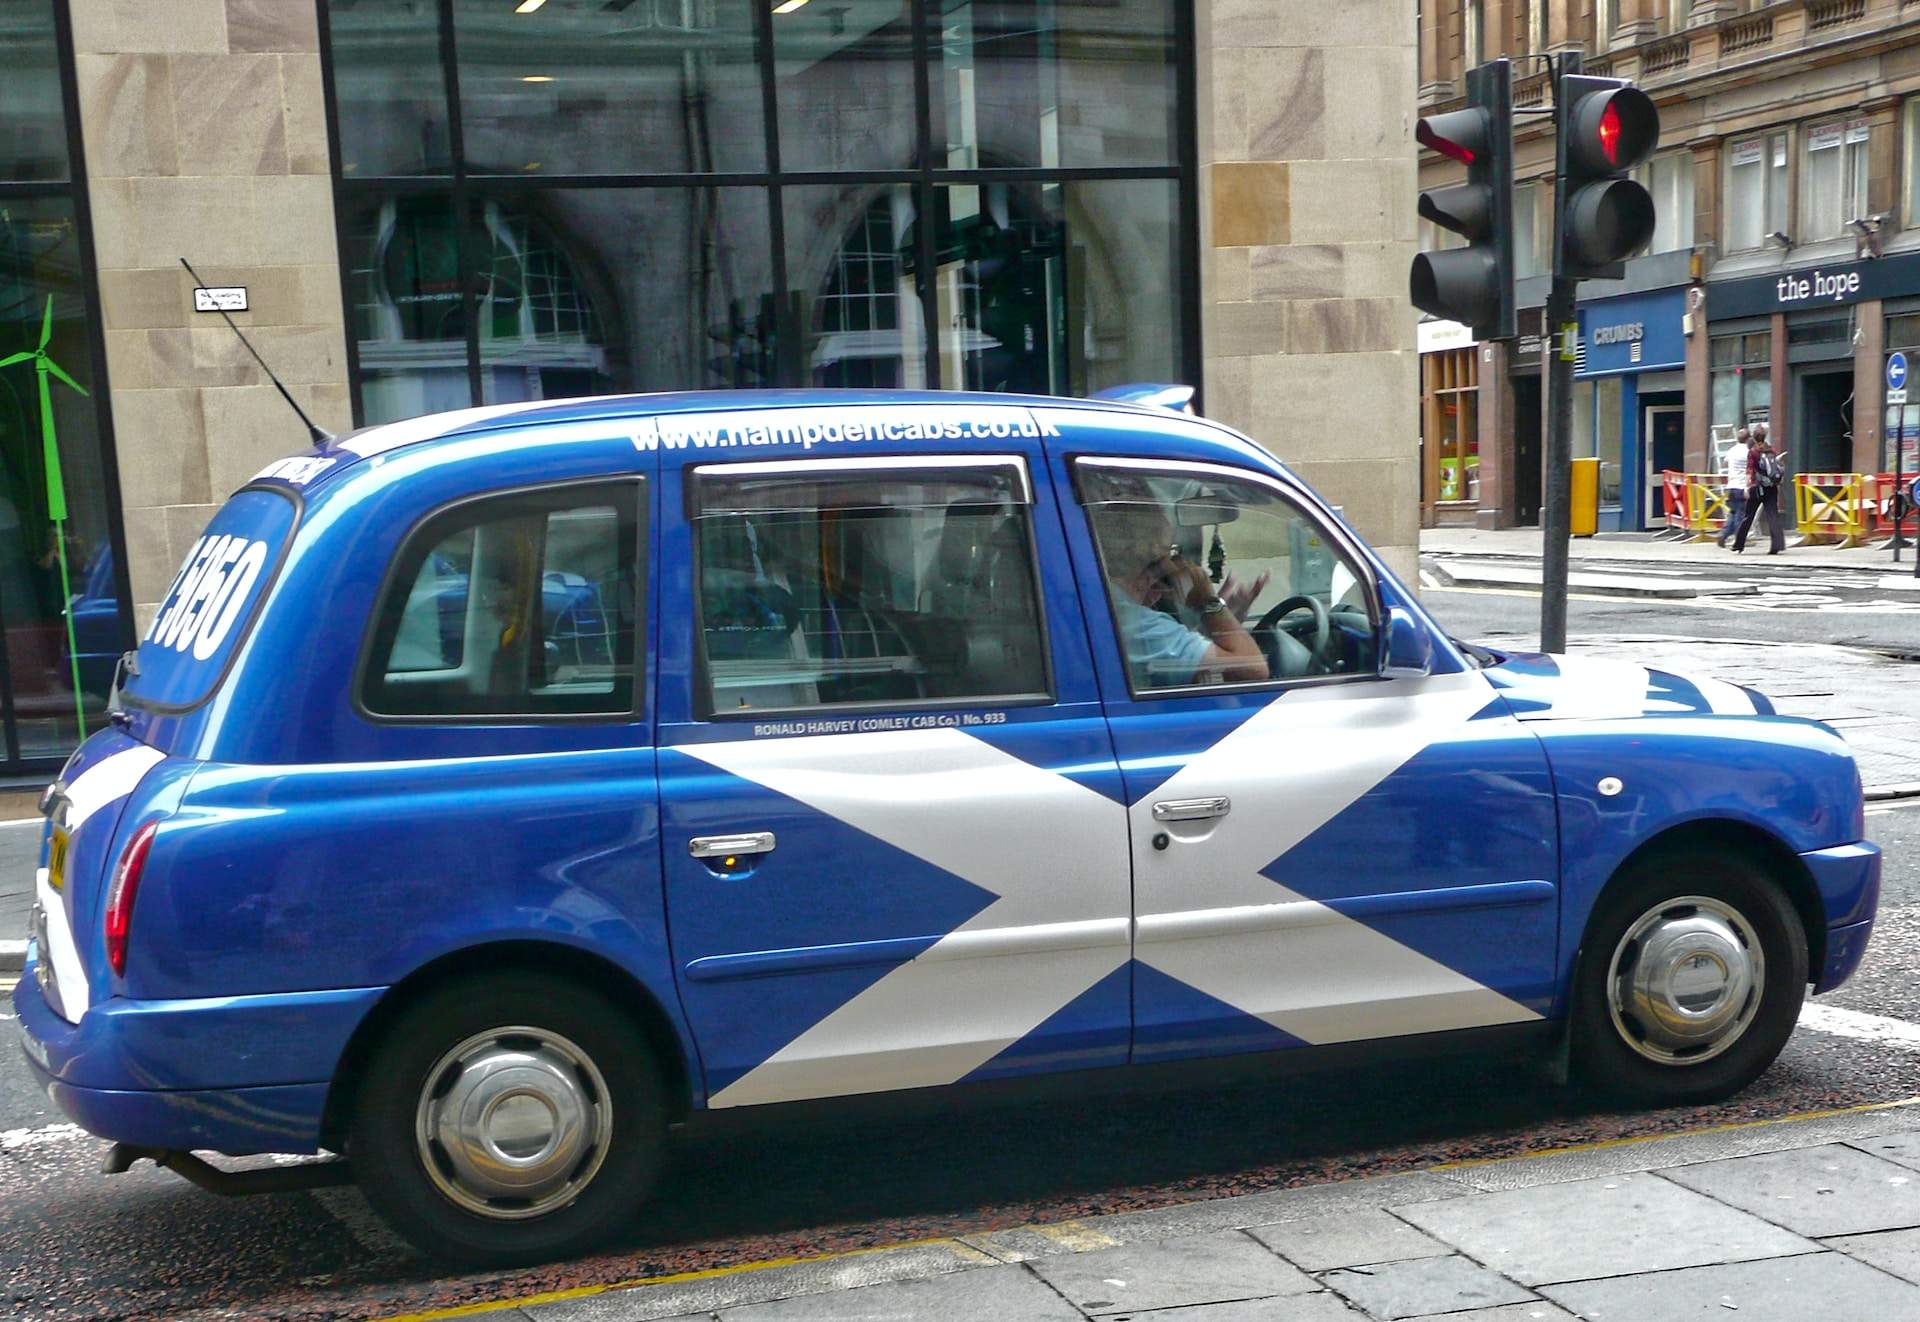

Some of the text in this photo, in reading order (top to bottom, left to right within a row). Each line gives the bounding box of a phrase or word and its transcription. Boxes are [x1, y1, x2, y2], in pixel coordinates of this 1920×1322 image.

[1777, 271, 1860, 302] the hope
[1594, 322, 1644, 345] CRUMBS
[754, 723, 806, 737] RONALD
[807, 719, 856, 734] HARVEY
[857, 716, 910, 732] (COMLEY
[911, 715, 937, 728] CAB
